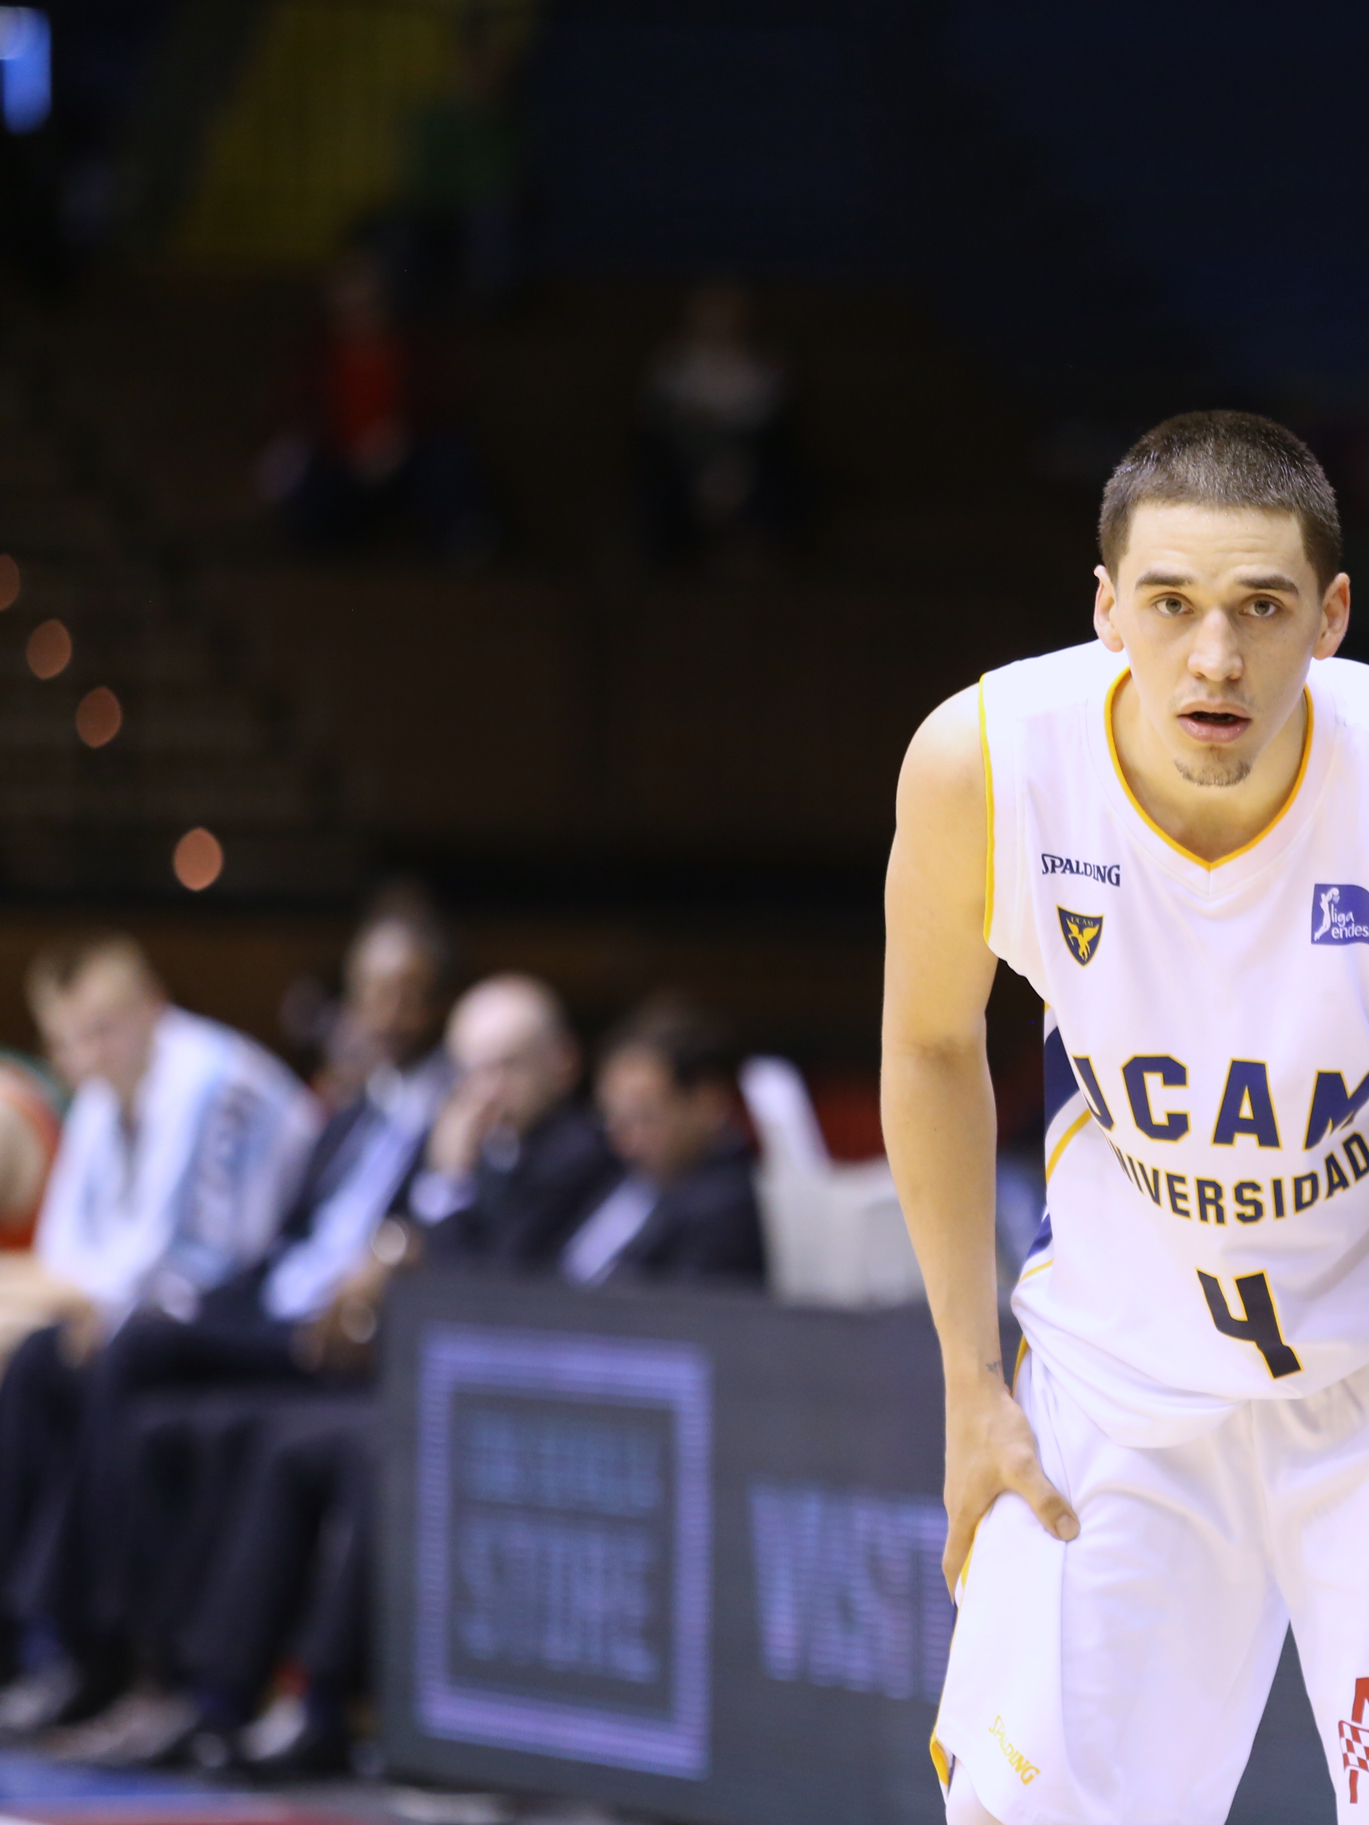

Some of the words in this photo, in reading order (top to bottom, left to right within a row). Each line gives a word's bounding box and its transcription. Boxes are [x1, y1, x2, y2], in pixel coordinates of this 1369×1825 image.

[1041, 853, 1121, 887] SPALDING
[1331, 903, 1354, 927] liga
[1195, 1268, 1304, 1380] 4
